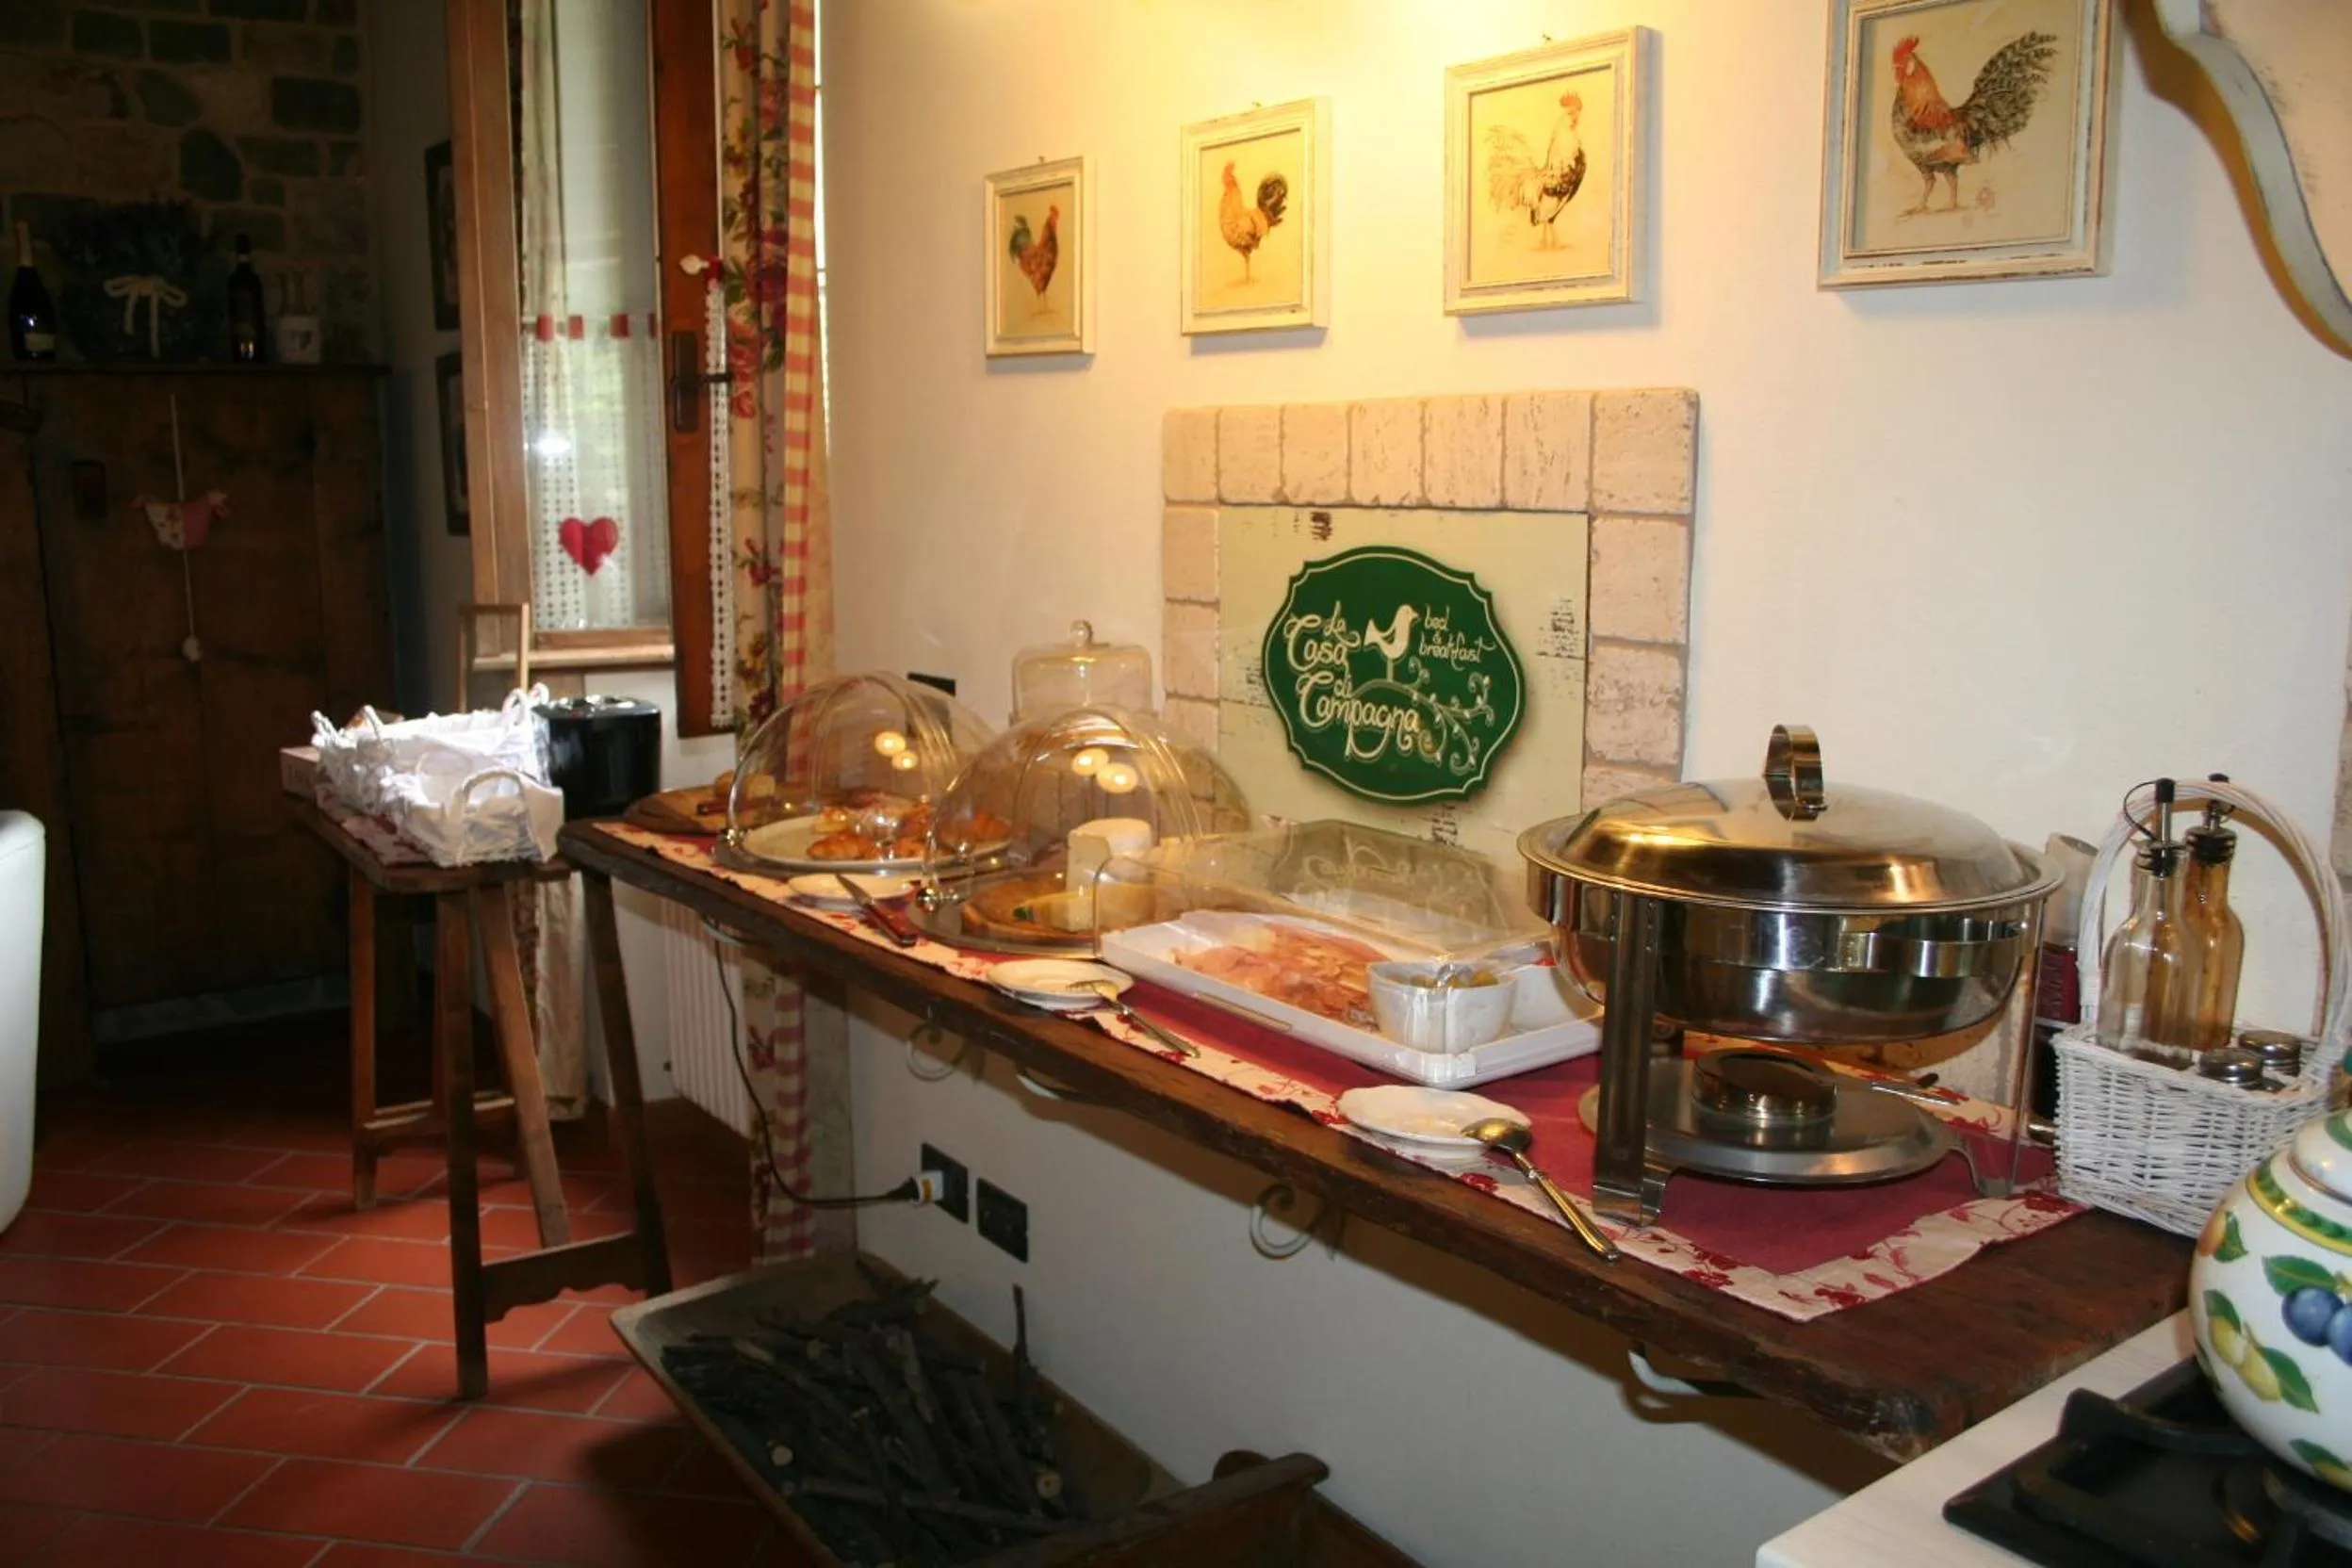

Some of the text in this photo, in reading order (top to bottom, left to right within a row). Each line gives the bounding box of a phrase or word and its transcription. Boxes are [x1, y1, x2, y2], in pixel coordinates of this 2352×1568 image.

[1424, 604, 1450, 631] bed
[1283, 613, 1351, 672] Casa
[1418, 631, 1497, 671] breakfast
[1333, 673, 1353, 698] di
[1295, 670, 1421, 759] Campagna
